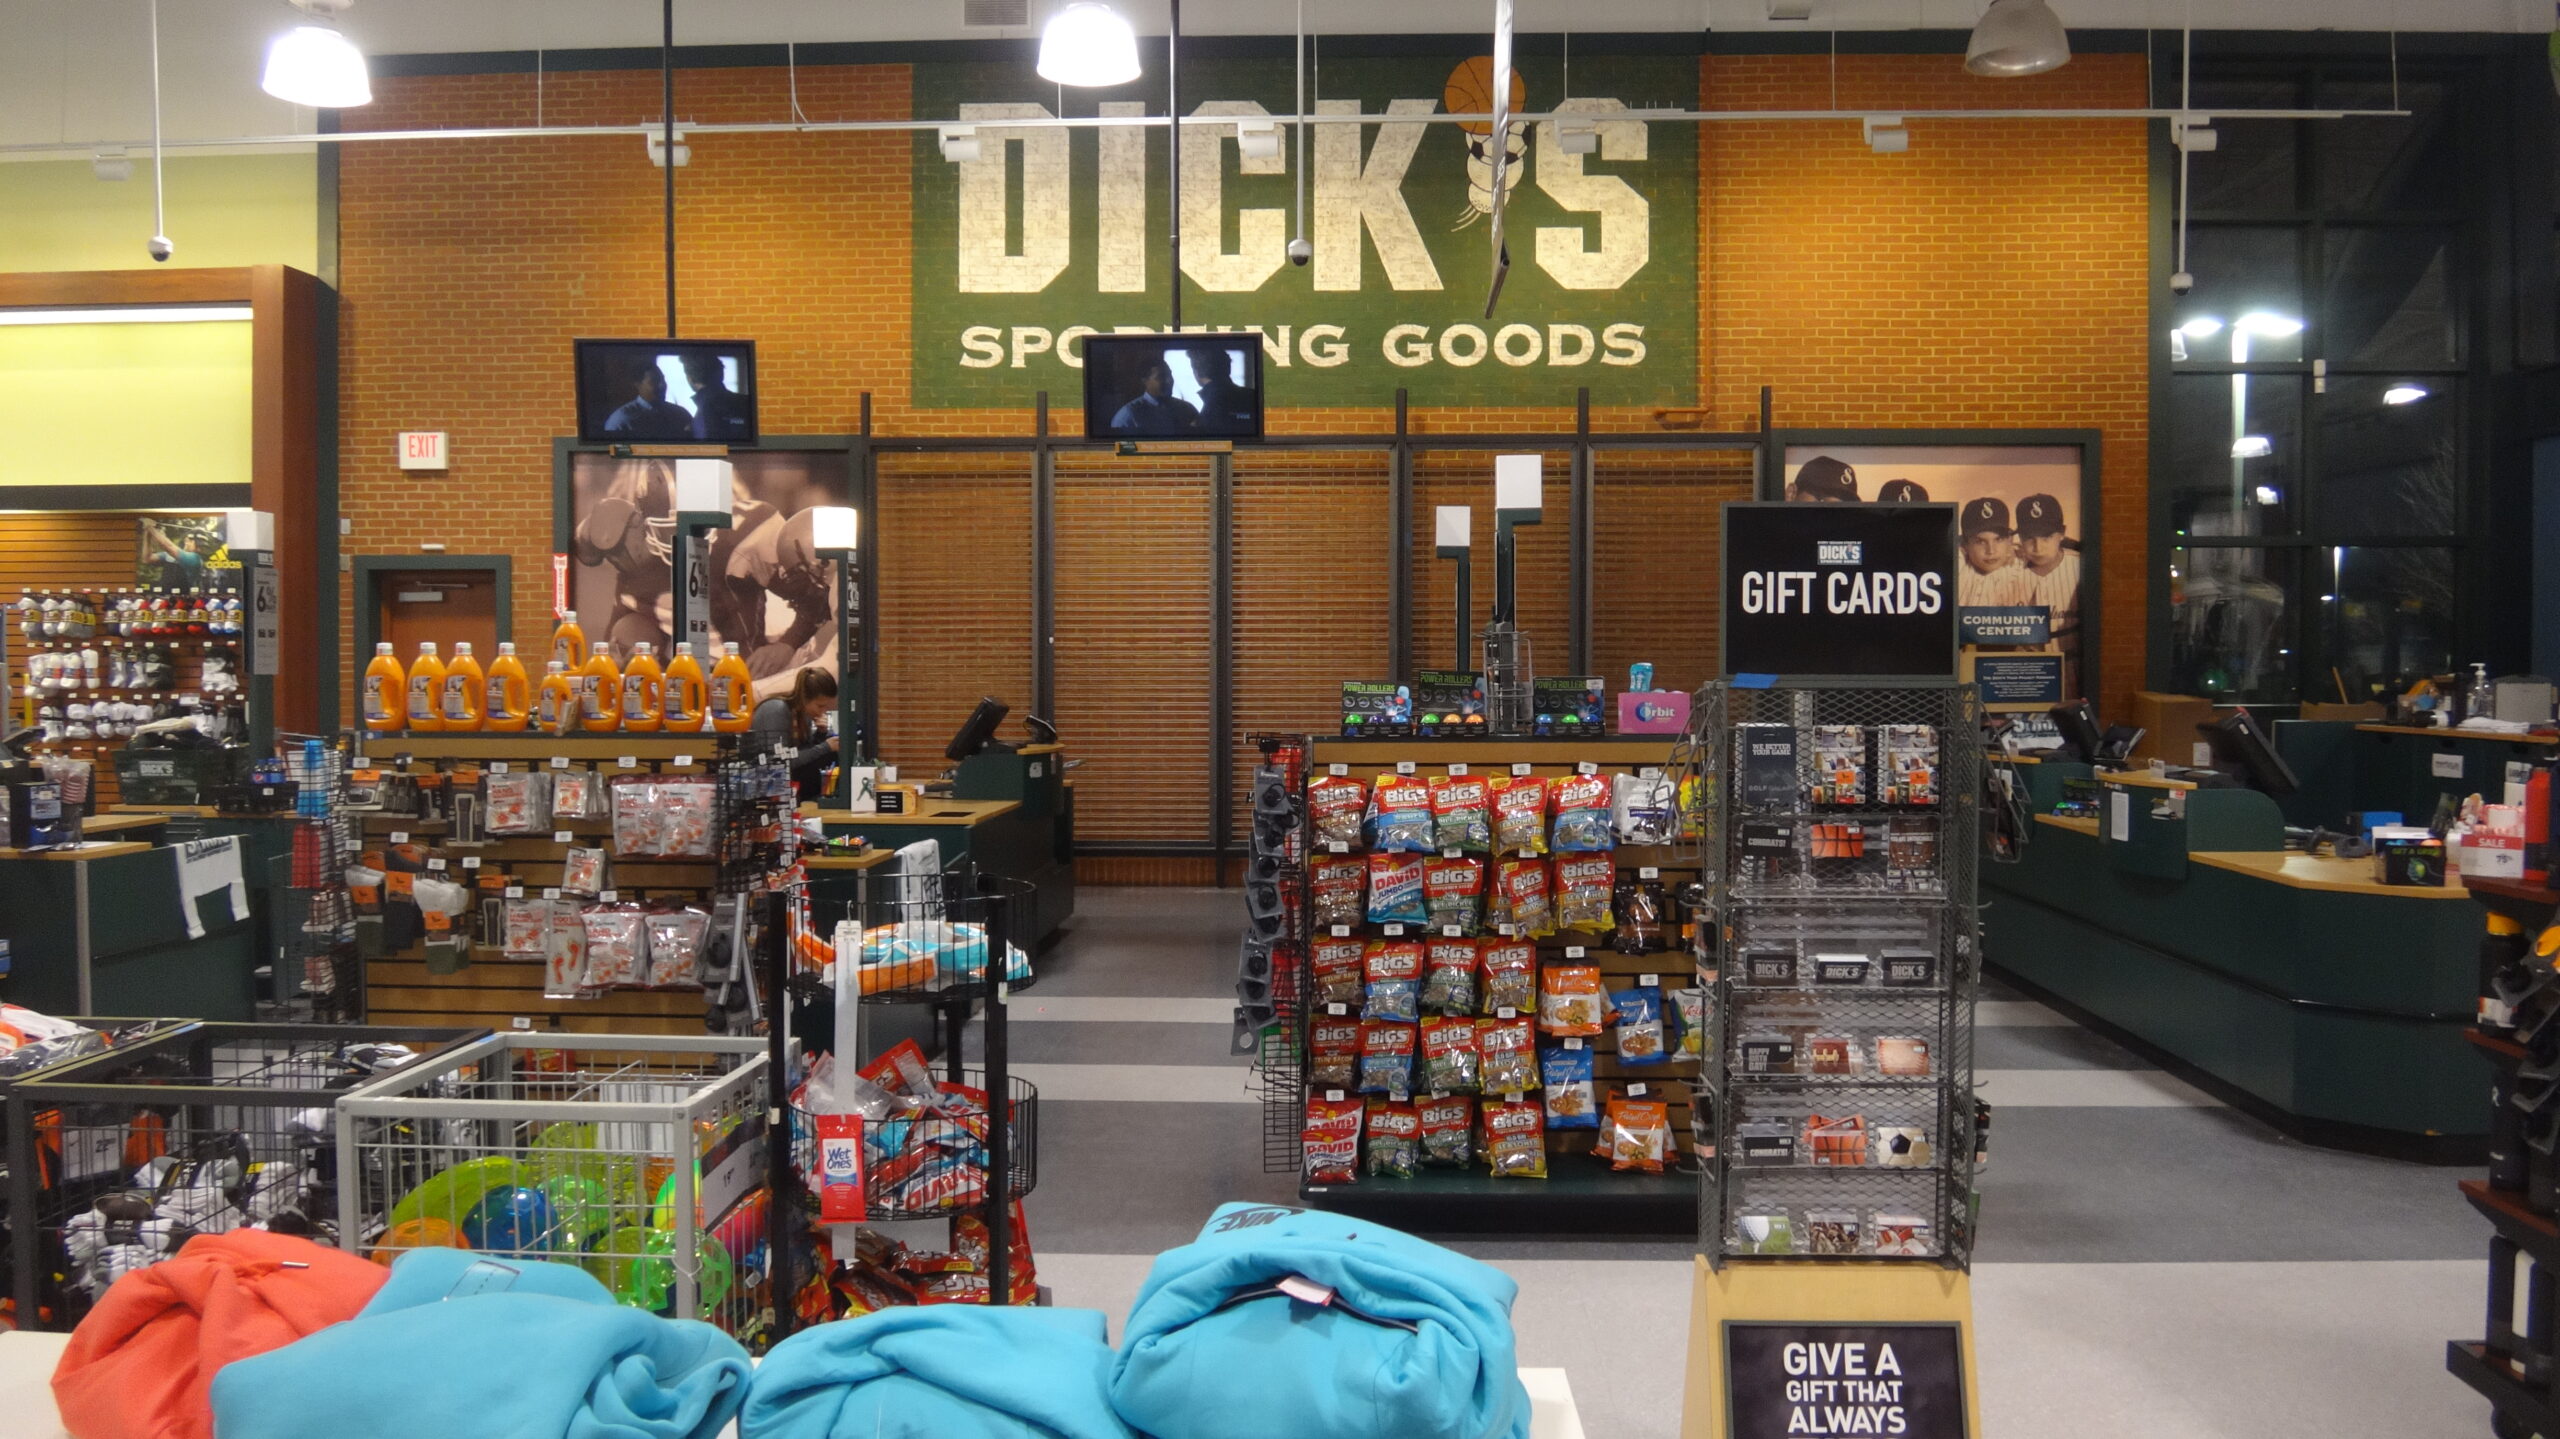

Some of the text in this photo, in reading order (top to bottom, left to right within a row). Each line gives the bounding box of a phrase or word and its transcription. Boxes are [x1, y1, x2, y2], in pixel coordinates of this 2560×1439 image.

[957, 97, 1649, 293] DICK'S
[959, 323, 1648, 369] SPONG GOODS
[408, 434, 438, 458] EXIT
[1819, 545, 1860, 560] DICK'S
[204, 560, 243, 569] adidas
[1742, 571, 1942, 615] GIFT CARDS
[1963, 615, 2046, 625] COMMUNITY
[1977, 626, 2031, 636] CENTER
[1420, 674, 1473, 684] POWER ROLLERS
[1535, 680, 1558, 689] POWER
[1367, 685, 1396, 693] ROLLERS
[1641, 705, 1675, 720] Orbit
[1748, 838, 1787, 847] CONGRATS!
[2478, 838, 2505, 848] SALE
[1377, 885, 1404, 900] JUMBO
[1755, 963, 1788, 976] DICK'S
[1826, 967, 1859, 977] DICK'S
[1892, 965, 1925, 977] DICK'S
[827, 1147, 852, 1161] Wet
[1750, 1148, 1788, 1157] CONGRATS!
[827, 1159, 852, 1170] Ones
[1213, 1211, 1288, 1234] NIKE
[1783, 1343, 1902, 1376] GIVE A
[1786, 1380, 1903, 1402] GIFT THAT
[1788, 1406, 1906, 1433] ALWAYS
